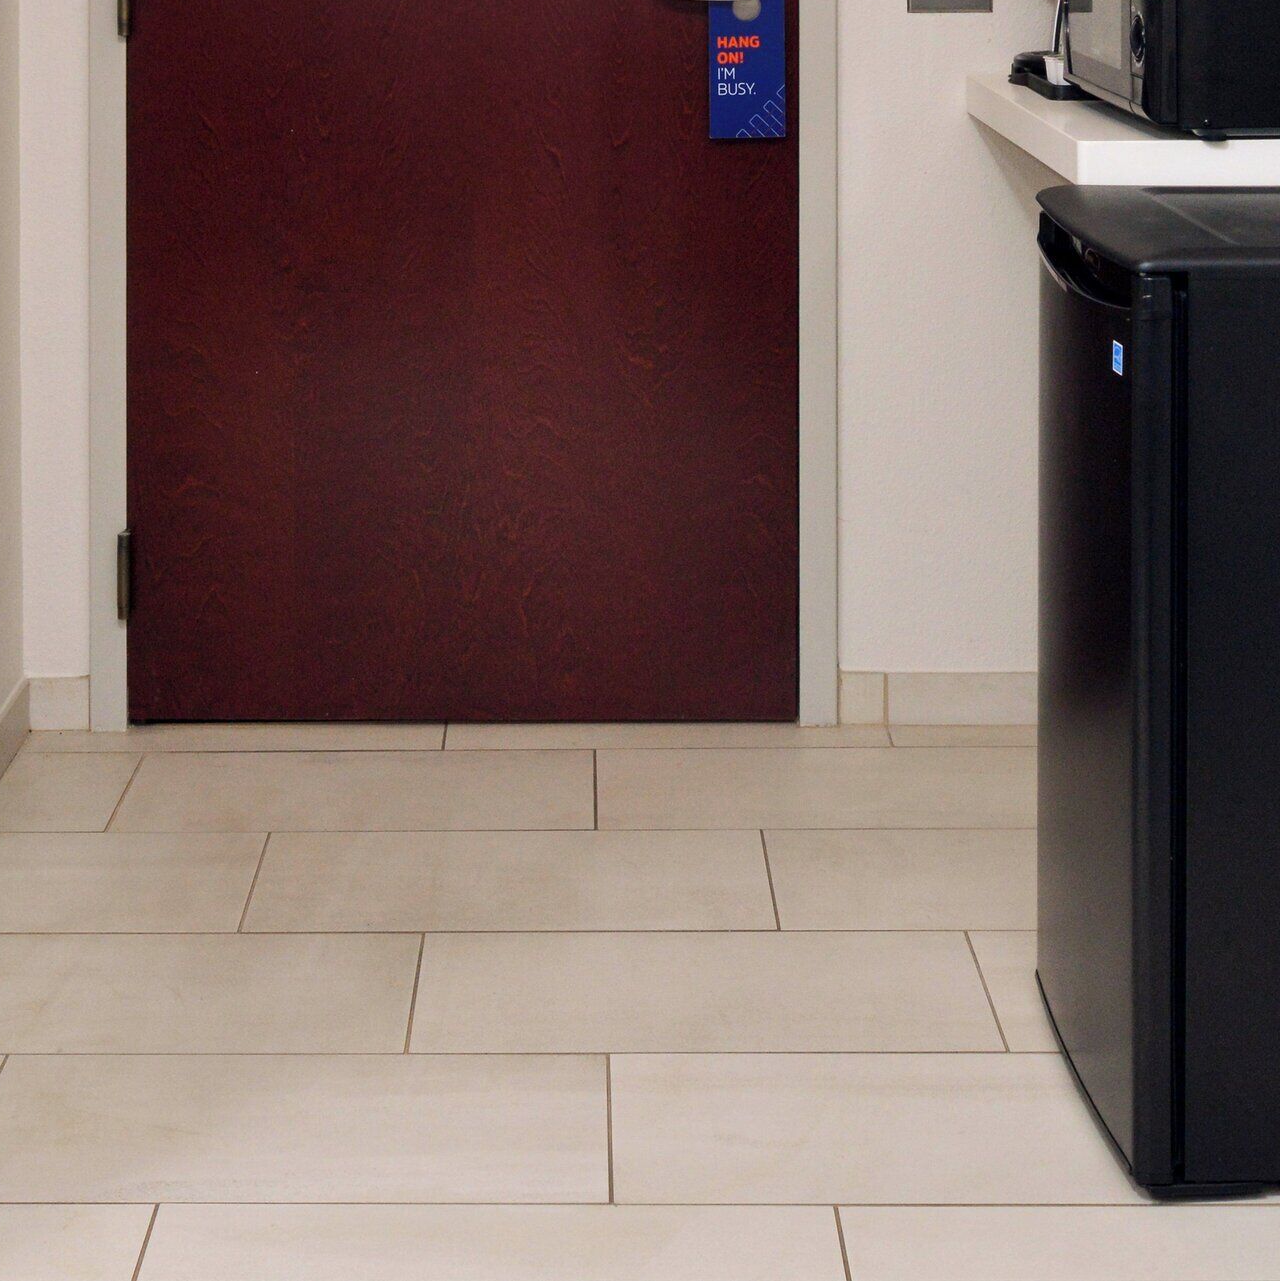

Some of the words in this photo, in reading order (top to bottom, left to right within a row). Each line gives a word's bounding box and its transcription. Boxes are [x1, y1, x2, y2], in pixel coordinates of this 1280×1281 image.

[717, 35, 760, 48] HANG
[717, 52, 744, 64] ON!
[717, 67, 736, 80] I'M
[717, 82, 757, 96] BUSY.
